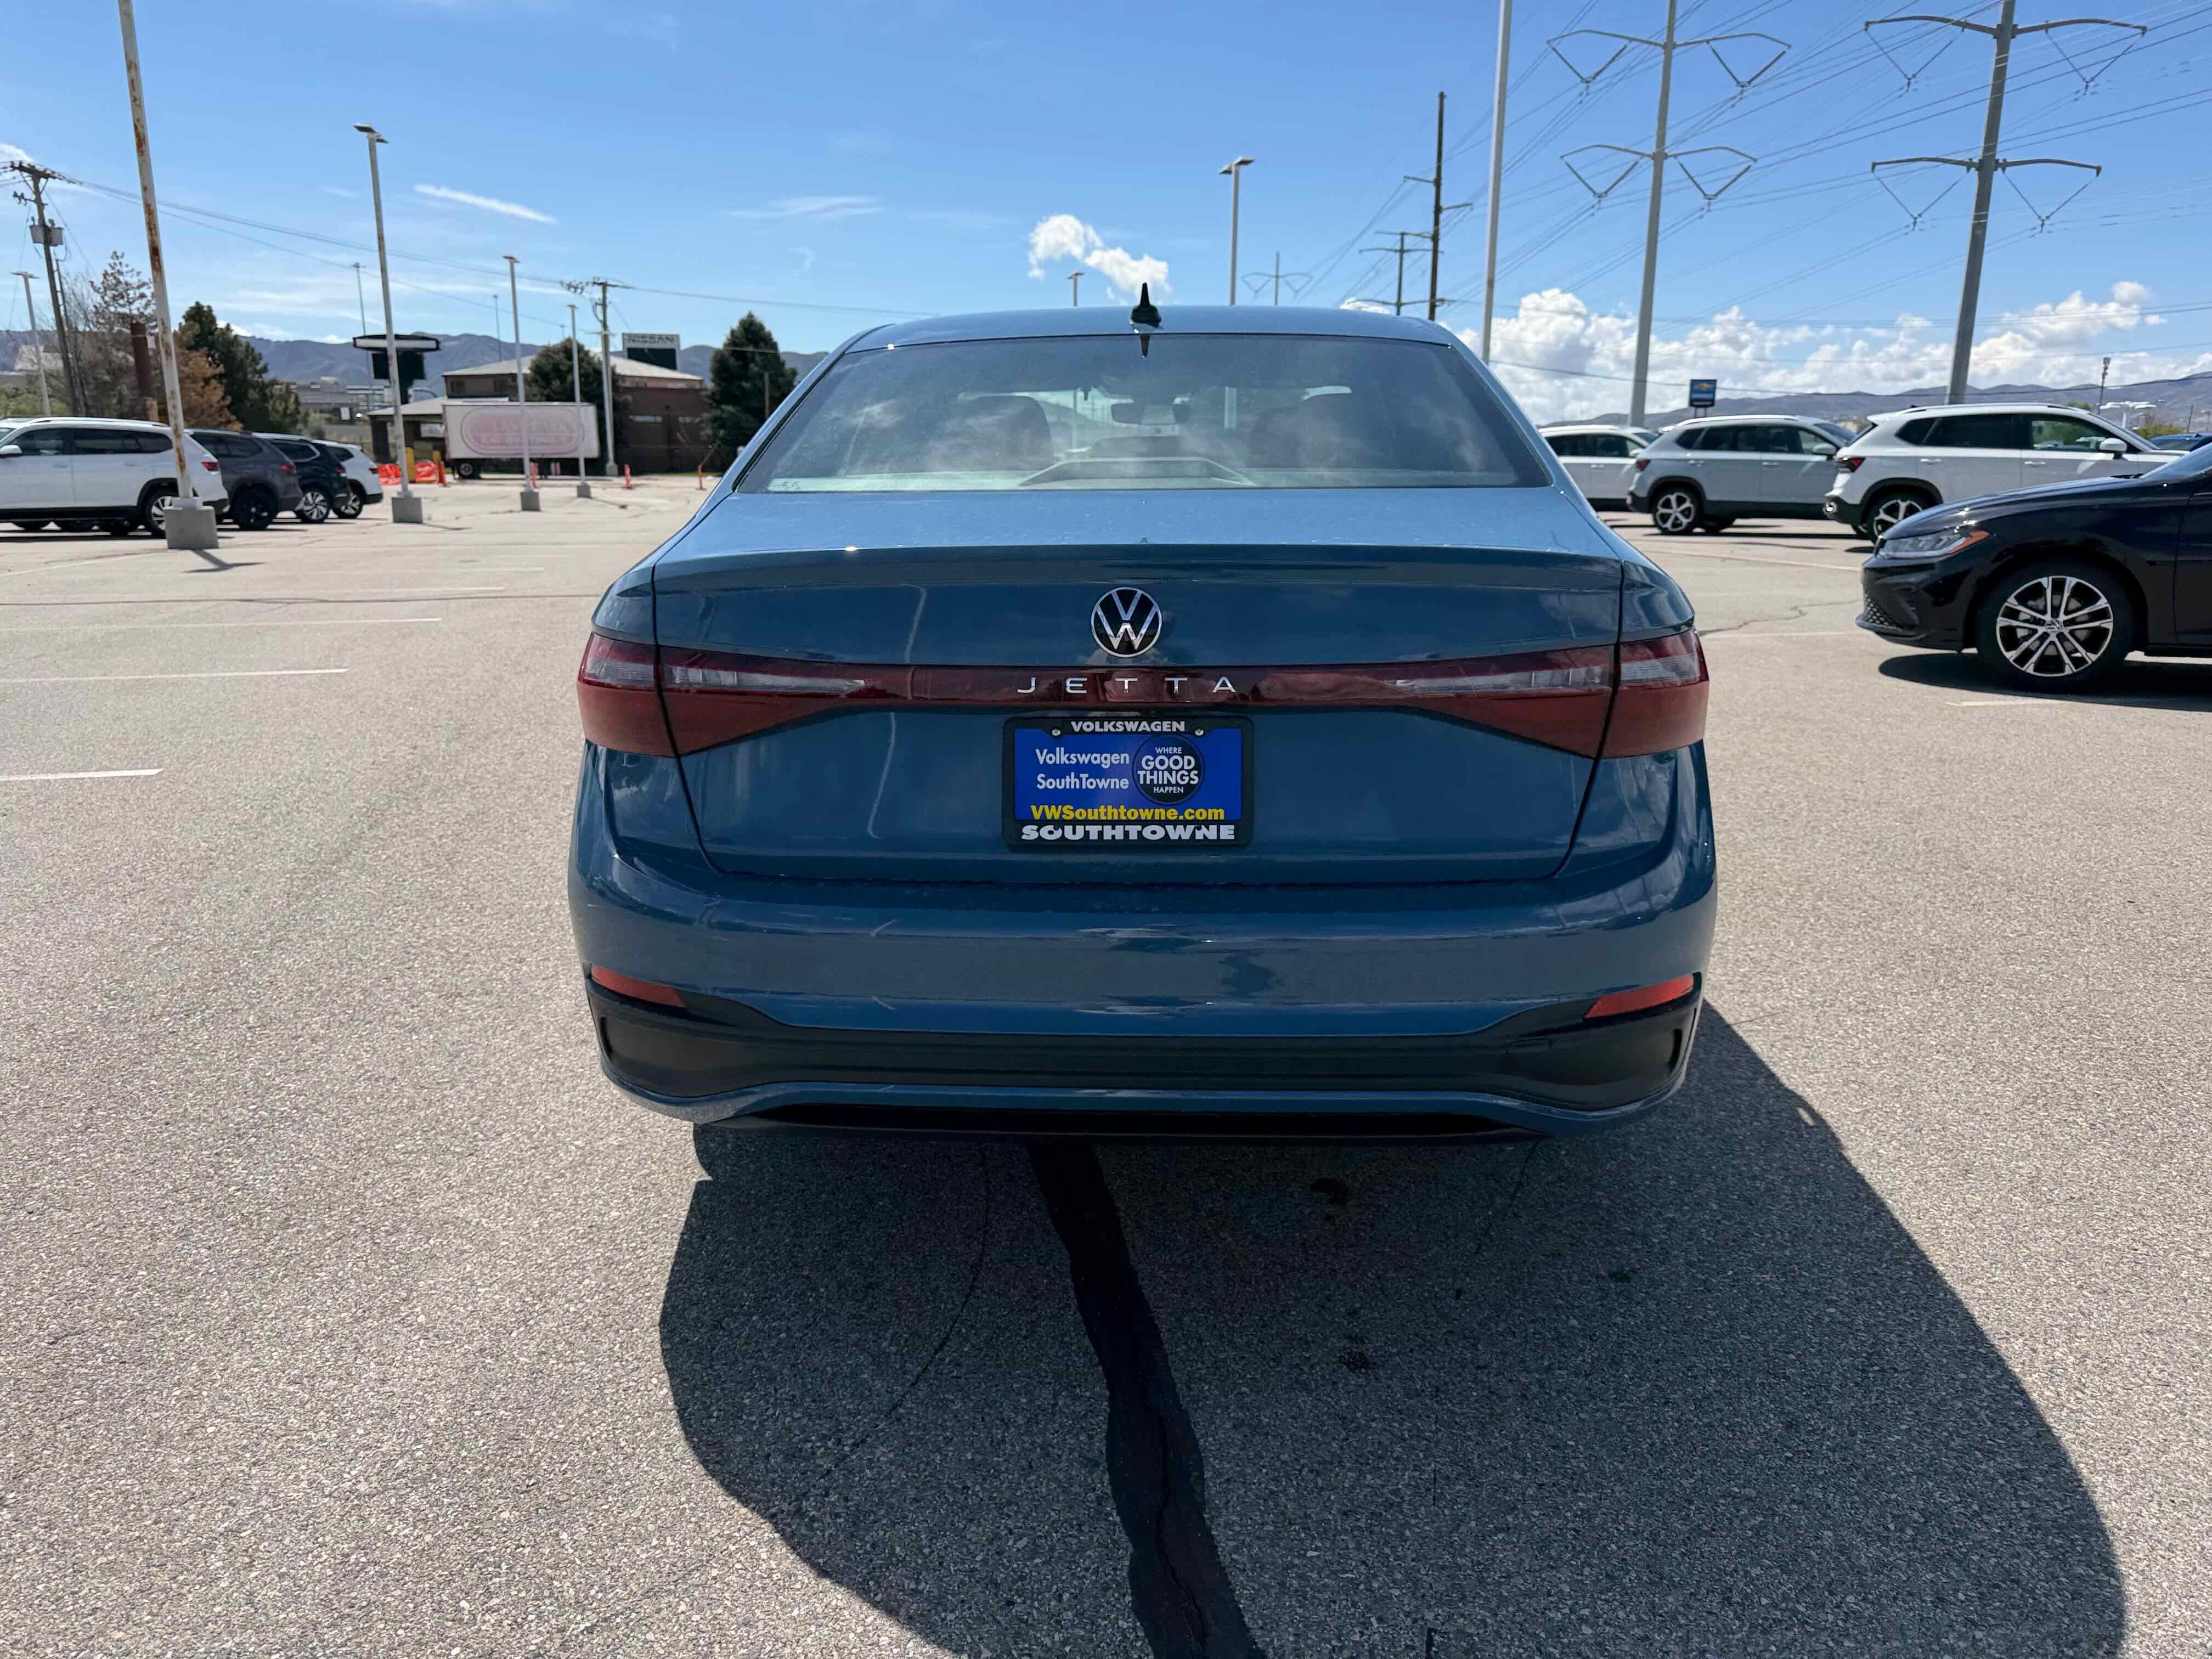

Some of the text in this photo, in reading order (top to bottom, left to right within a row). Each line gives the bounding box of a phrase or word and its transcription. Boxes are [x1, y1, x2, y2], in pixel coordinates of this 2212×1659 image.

[1017, 676, 1236, 694] JETTA
[1070, 720, 1186, 732] VOLKSWAGEN
[1035, 747, 1130, 769] Volkswagen
[1141, 755, 1195, 770] GOOD
[1036, 773, 1130, 789] SouthTowne
[1137, 770, 1199, 786] THINGS
[1030, 805, 1225, 821] VWSouthtowne.com
[1020, 825, 1235, 840] SOUTHTOWNE
